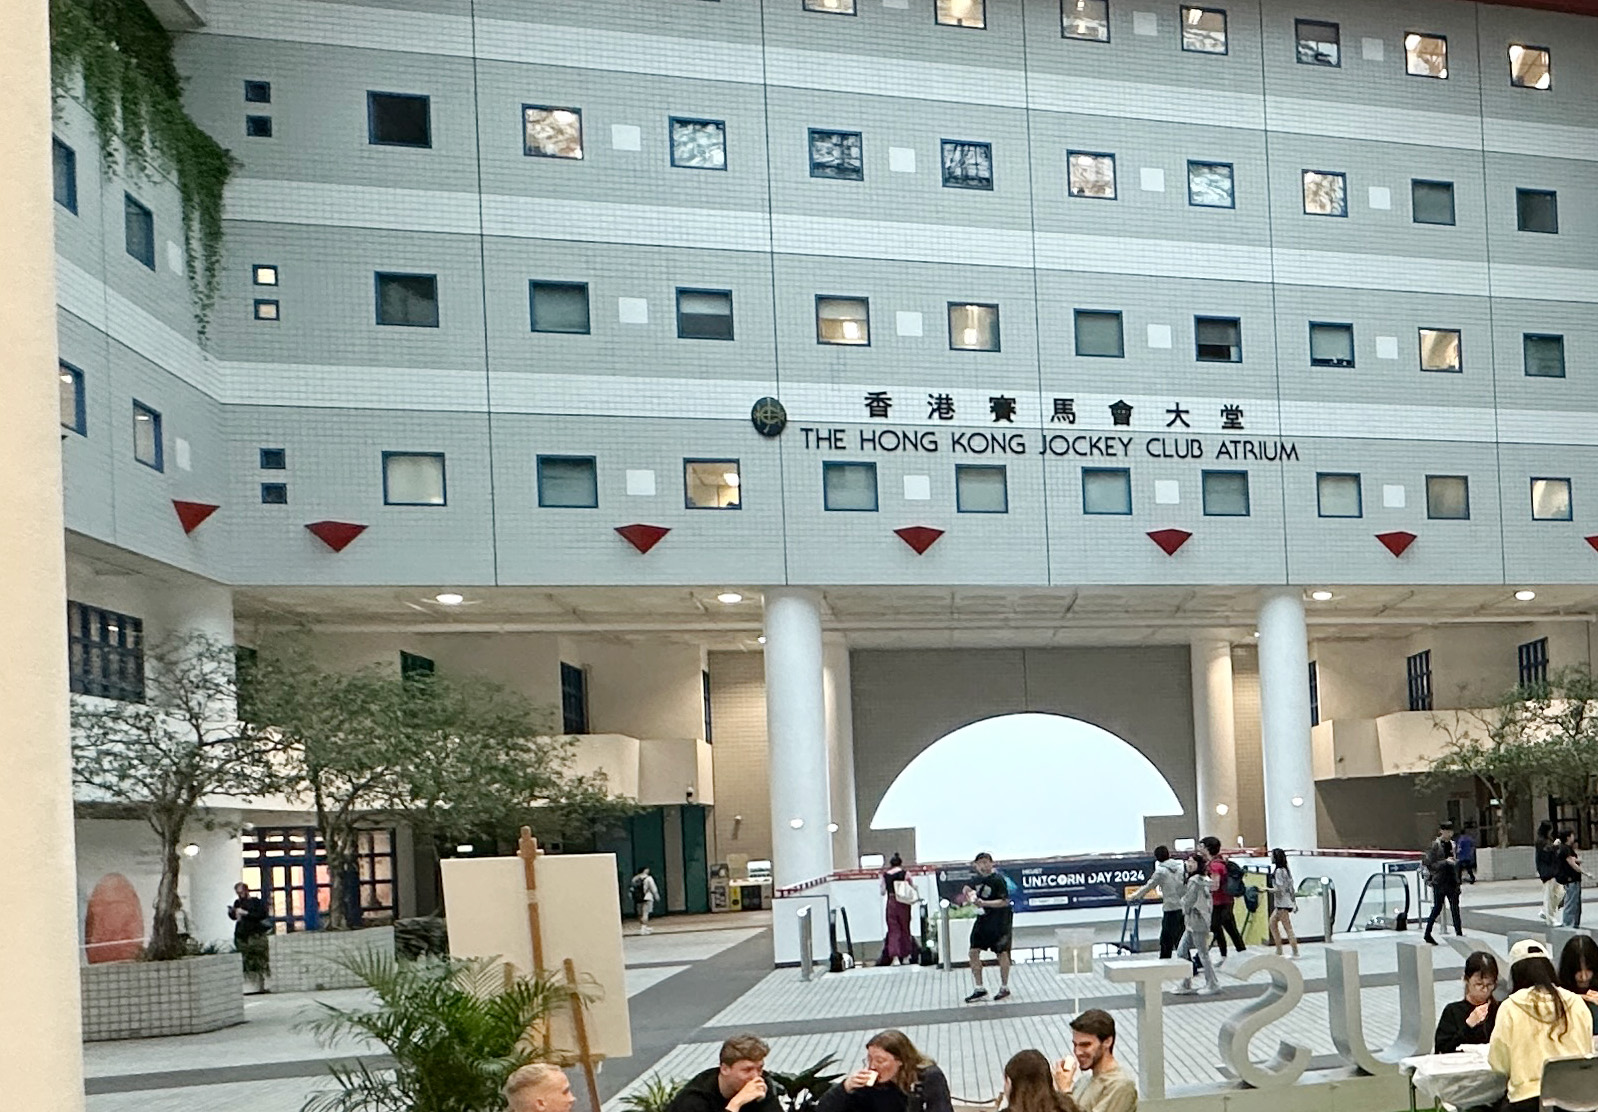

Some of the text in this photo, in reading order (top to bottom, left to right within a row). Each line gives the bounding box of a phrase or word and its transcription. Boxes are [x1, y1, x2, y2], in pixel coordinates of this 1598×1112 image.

[864, 391, 1244, 430] 香港賽馬會大堂
[800, 427, 1300, 461] THE HONG KONG JOCKEY CLUB ATRIUM
[1022, 870, 1145, 888] UNICORN DAY 2024
